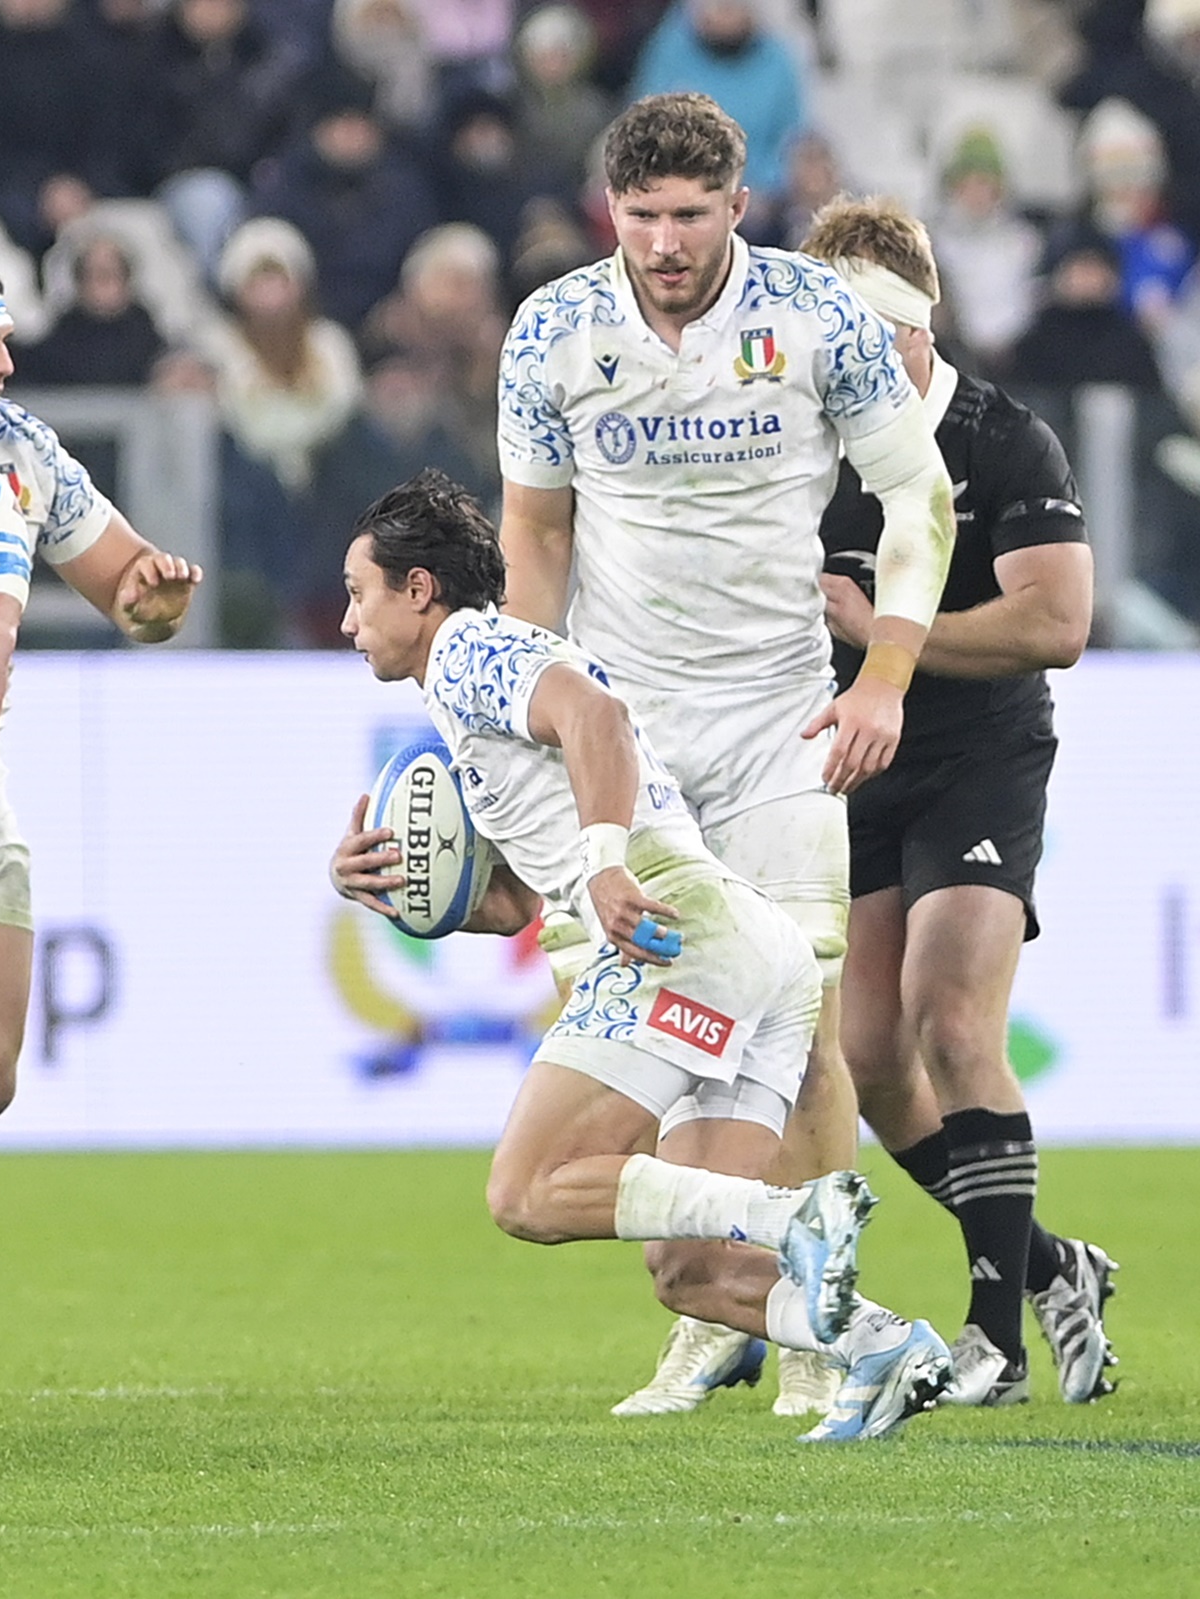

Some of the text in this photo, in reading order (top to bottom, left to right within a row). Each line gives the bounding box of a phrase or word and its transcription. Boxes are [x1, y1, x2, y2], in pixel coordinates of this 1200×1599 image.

[637, 411, 782, 442] Vittoria
[644, 442, 782, 465] Assicurazioni
[406, 766, 436, 919] GILBERT
[658, 1002, 725, 1046] AVIS
